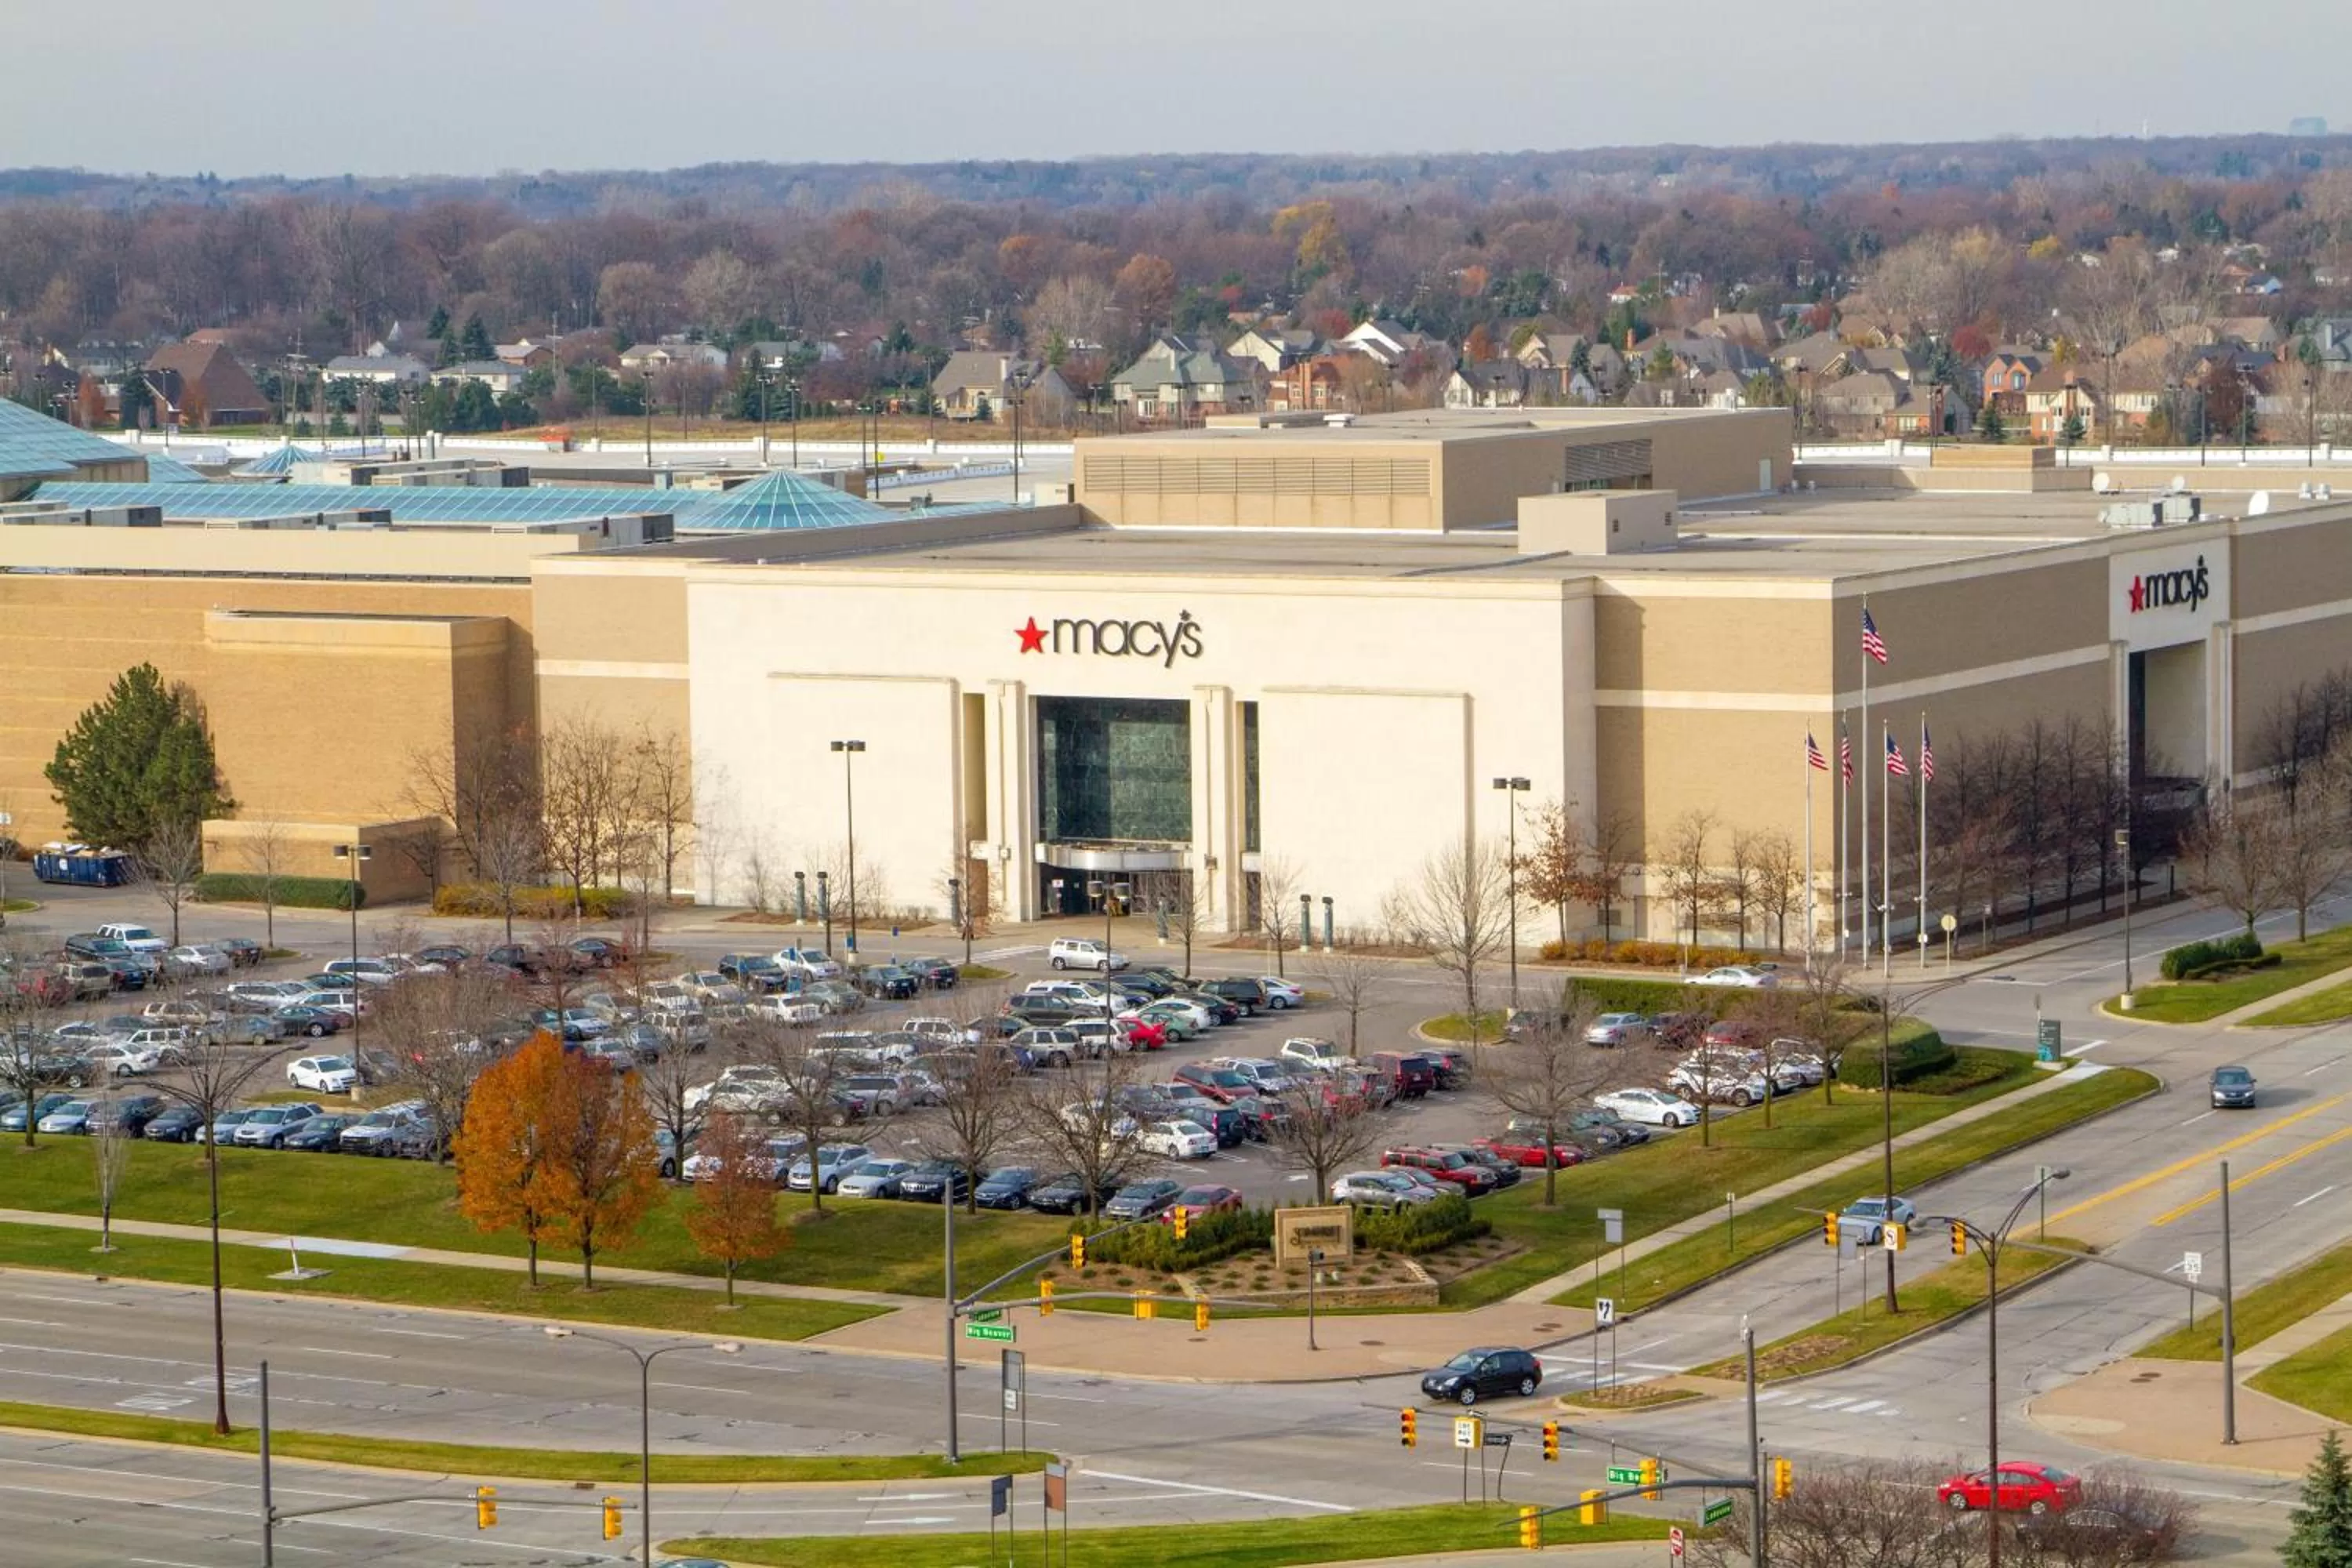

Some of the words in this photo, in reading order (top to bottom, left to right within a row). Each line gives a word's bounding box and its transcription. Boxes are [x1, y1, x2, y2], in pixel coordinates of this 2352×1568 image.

[2146, 554, 2209, 612] macy's
[1054, 609, 1203, 669] macy's
[968, 1327, 981, 1337] Big
[982, 1327, 1011, 1338] Beaver
[1609, 1470, 1624, 1482] Big
